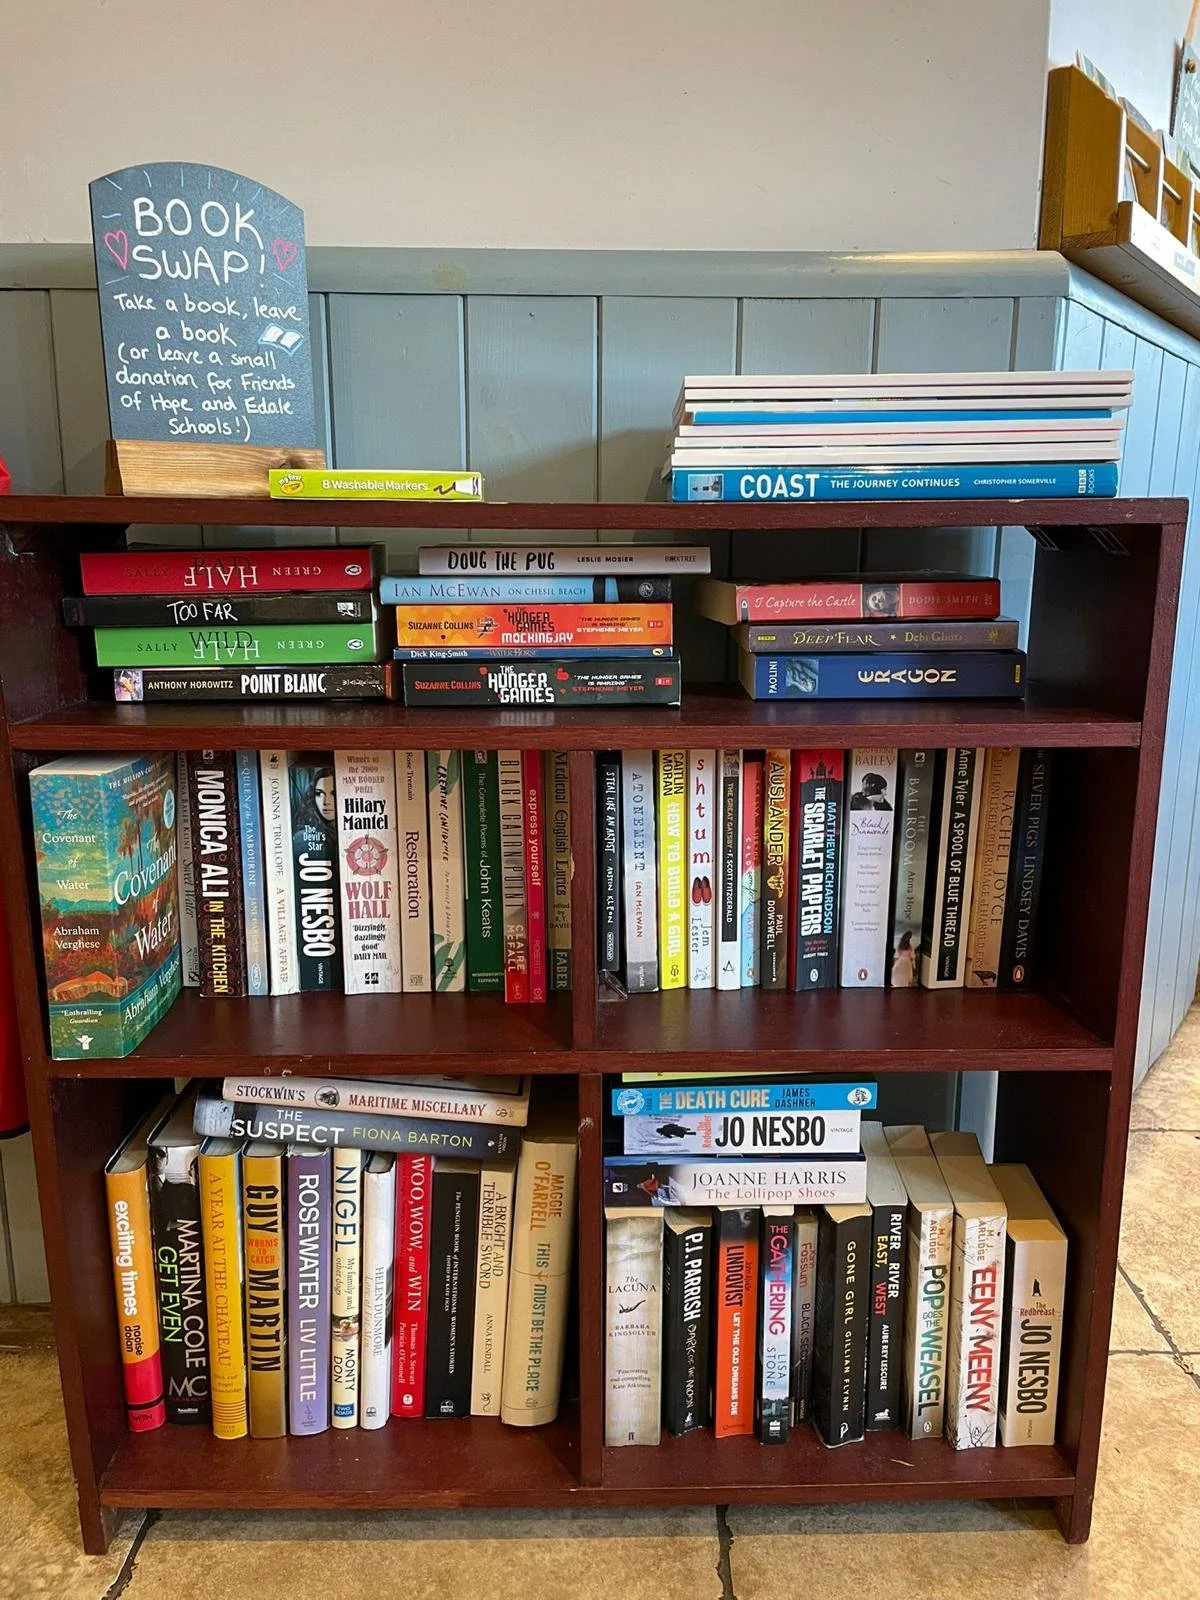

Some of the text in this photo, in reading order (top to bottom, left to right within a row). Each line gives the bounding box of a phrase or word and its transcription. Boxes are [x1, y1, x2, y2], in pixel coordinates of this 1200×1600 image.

[133, 196, 263, 249] BOOK
[131, 246, 265, 288] SWAP!
[113, 293, 302, 320] Take a book, leave
[156, 324, 237, 346] a book
[117, 343, 276, 369] (or leave a small
[115, 369, 295, 395] donation for Friends
[120, 392, 293, 414] of Hope and Edale
[169, 416, 250, 441] Schools!)
[323, 480, 428, 490] 8 Washable Markers
[739, 474, 819, 498] COAST
[831, 479, 850, 489] THE
[853, 479, 899, 489] JOURNEY
[901, 478, 960, 488] CONTINUES
[167, 600, 238, 624] TOO FAR
[137, 643, 177, 652] SALLY
[502, 632, 573, 643] MOCKINGJAY
[148, 681, 187, 689] ANTHONY
[190, 680, 233, 689] HOROWITZ
[241, 675, 282, 694] POINT
[284, 673, 327, 693] BLANC
[488, 673, 546, 691] HUNGER
[858, 669, 957, 682] ERAGON
[502, 687, 554, 702] GAMES
[663, 754, 672, 796] MORAN
[673, 753, 684, 794] CAITLIN
[855, 756, 896, 766] BAILEY
[344, 799, 386, 815] Hilary
[479, 788, 487, 822] Complete
[815, 786, 826, 801] THE
[343, 816, 388, 830] Mantel
[607, 816, 614, 826] AN
[802, 803, 825, 869] SCARLET
[903, 777, 919, 865] BALLROOM
[43, 834, 95, 843] Covenant
[605, 829, 614, 853] ARTIST
[481, 850, 488, 858] of
[824, 802, 836, 933] MATTHEW RICHARDSON
[1015, 764, 1045, 958] SILVER PIGS LINDSEY DAVIS
[56, 881, 89, 890] Water
[194, 771, 229, 993] MONICA ALI IN THE KITCHEN
[345, 881, 391, 900] WOLF
[405, 832, 421, 919] Restoration
[479, 859, 491, 894] John
[299, 853, 336, 957] JO NESBO
[348, 901, 390, 920] HALL
[481, 899, 492, 938] Keats
[801, 874, 821, 936] PAPERS
[54, 927, 99, 935] Abraham
[355, 934, 386, 942] dazzlingly
[692, 918, 701, 953] Lester
[767, 900, 775, 950] DOWSWELL
[55, 941, 100, 949] Verghese
[372, 952, 387, 960] MAIL
[675, 1090, 726, 1109] DEATH
[730, 1089, 769, 1108] CURE
[775, 1098, 815, 1108] DASHNER
[782, 1088, 809, 1097] JAMES
[277, 1110, 302, 1121] THE
[232, 1119, 344, 1145] SUSPECT
[352, 1127, 472, 1147] FIONA BARTON
[715, 1116, 825, 1147] JO NESBO
[693, 1170, 846, 1189] JOANNE HARRIS
[245, 1184, 279, 1233] GUY
[335, 1166, 356, 1252] NIGEL
[530, 1162, 551, 1231] O'FARRELL
[549, 1175, 564, 1218] MAGGIE
[114, 1200, 140, 1316] exciting times
[177, 1219, 204, 1310] MARTINA
[846, 1241, 856, 1284] GONE
[888, 1214, 902, 1298] RIVER RIVER
[298, 1175, 319, 1401] ROSEWATER LIV LITTLE
[725, 1246, 744, 1306] LINDQVIST
[769, 1236, 788, 1335] GATHERING
[158, 1246, 182, 1342] GET EVEN
[845, 1291, 854, 1324] GIRL
[249, 1269, 281, 1372] MARTIN
[526, 1243, 550, 1391] THIS MUST BE THE PLACE
[183, 1316, 206, 1368] COLE
[484, 1338, 492, 1373] KENDALL
[333, 1356, 343, 1383] DON
[345, 1349, 355, 1391] MONTY
[880, 1360, 888, 1390] LESCURE
[918, 1327, 943, 1416] WEASEL
[1017, 1319, 1052, 1413] JO NESBO
